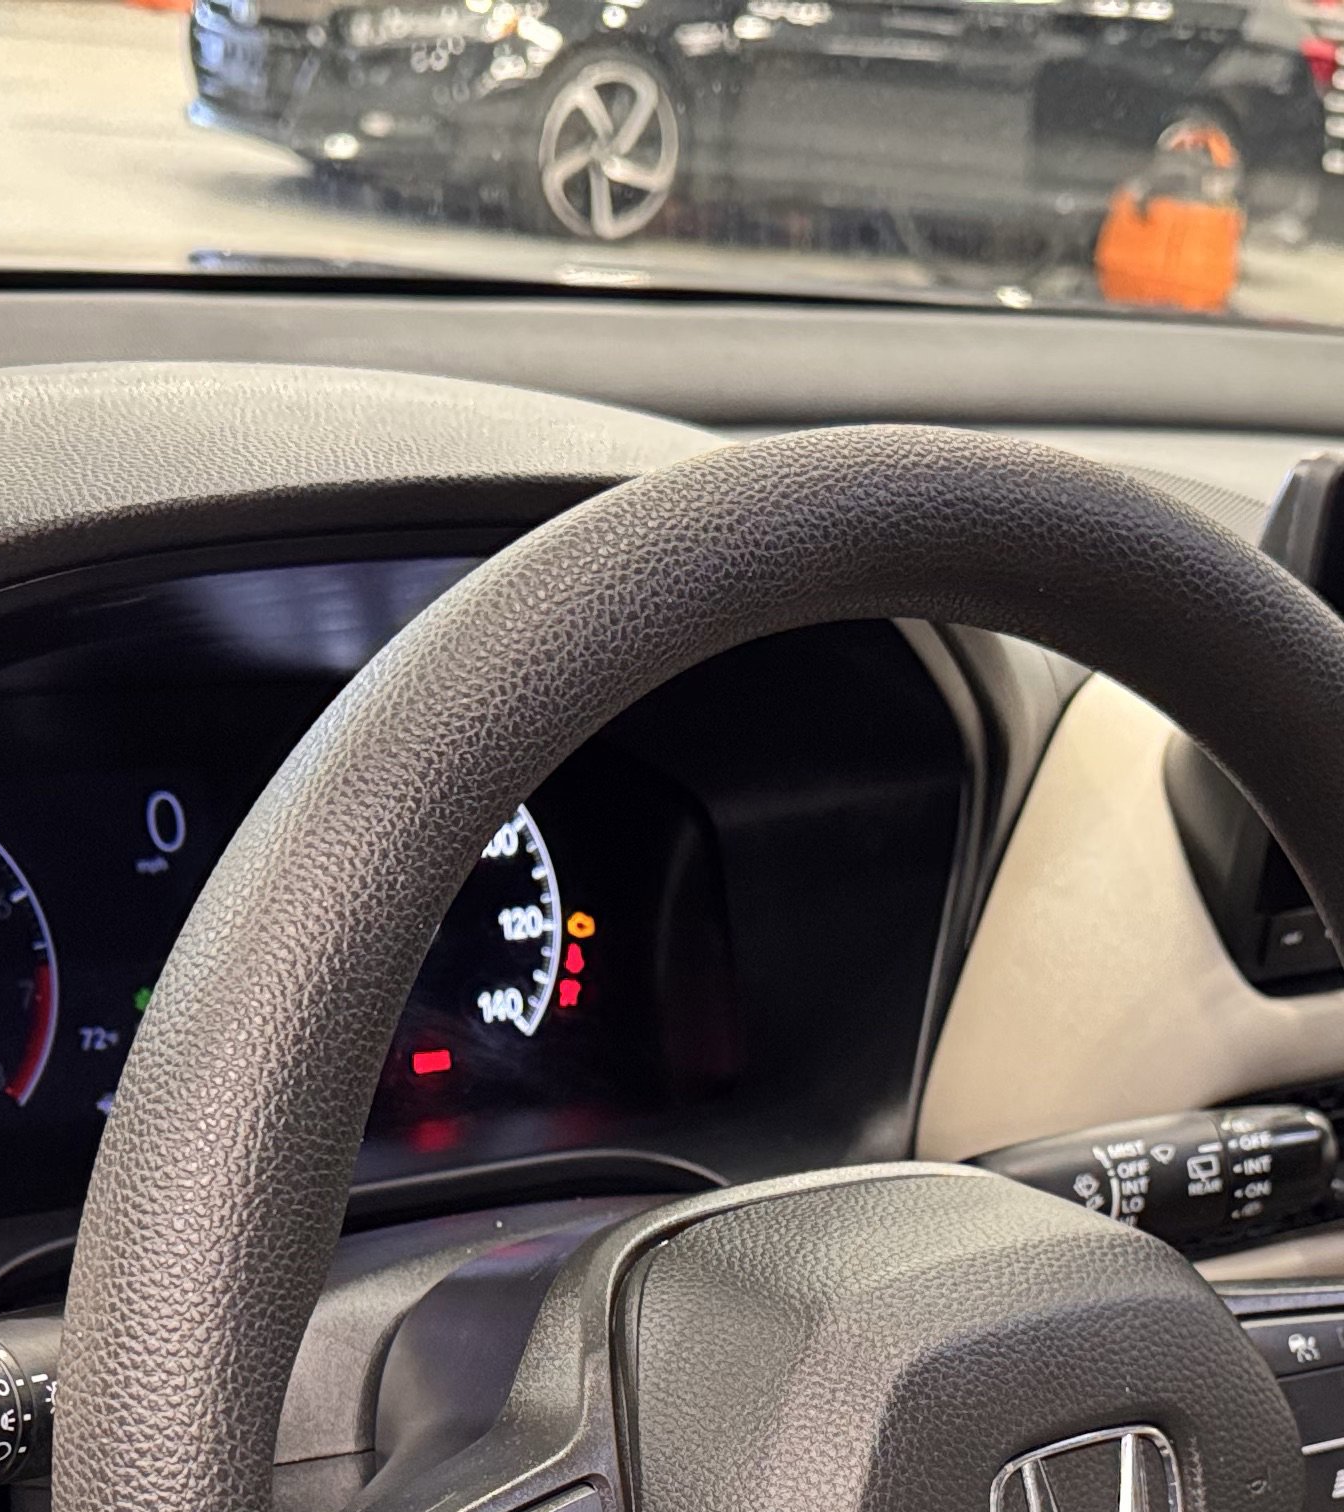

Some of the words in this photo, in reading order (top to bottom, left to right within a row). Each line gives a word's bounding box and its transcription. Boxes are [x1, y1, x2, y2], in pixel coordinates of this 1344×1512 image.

[146, 790, 186, 853] 0
[481, 822, 519, 858] 00
[498, 906, 544, 941] 120
[477, 988, 524, 1024] 140
[1239, 1132, 1272, 1150] OFF
[1117, 1159, 1150, 1178] OFF
[1243, 1155, 1272, 1175] INT
[1121, 1178, 1150, 1195] INT
[1244, 1180, 1272, 1199] ON
[1121, 1196, 1146, 1214] LO
